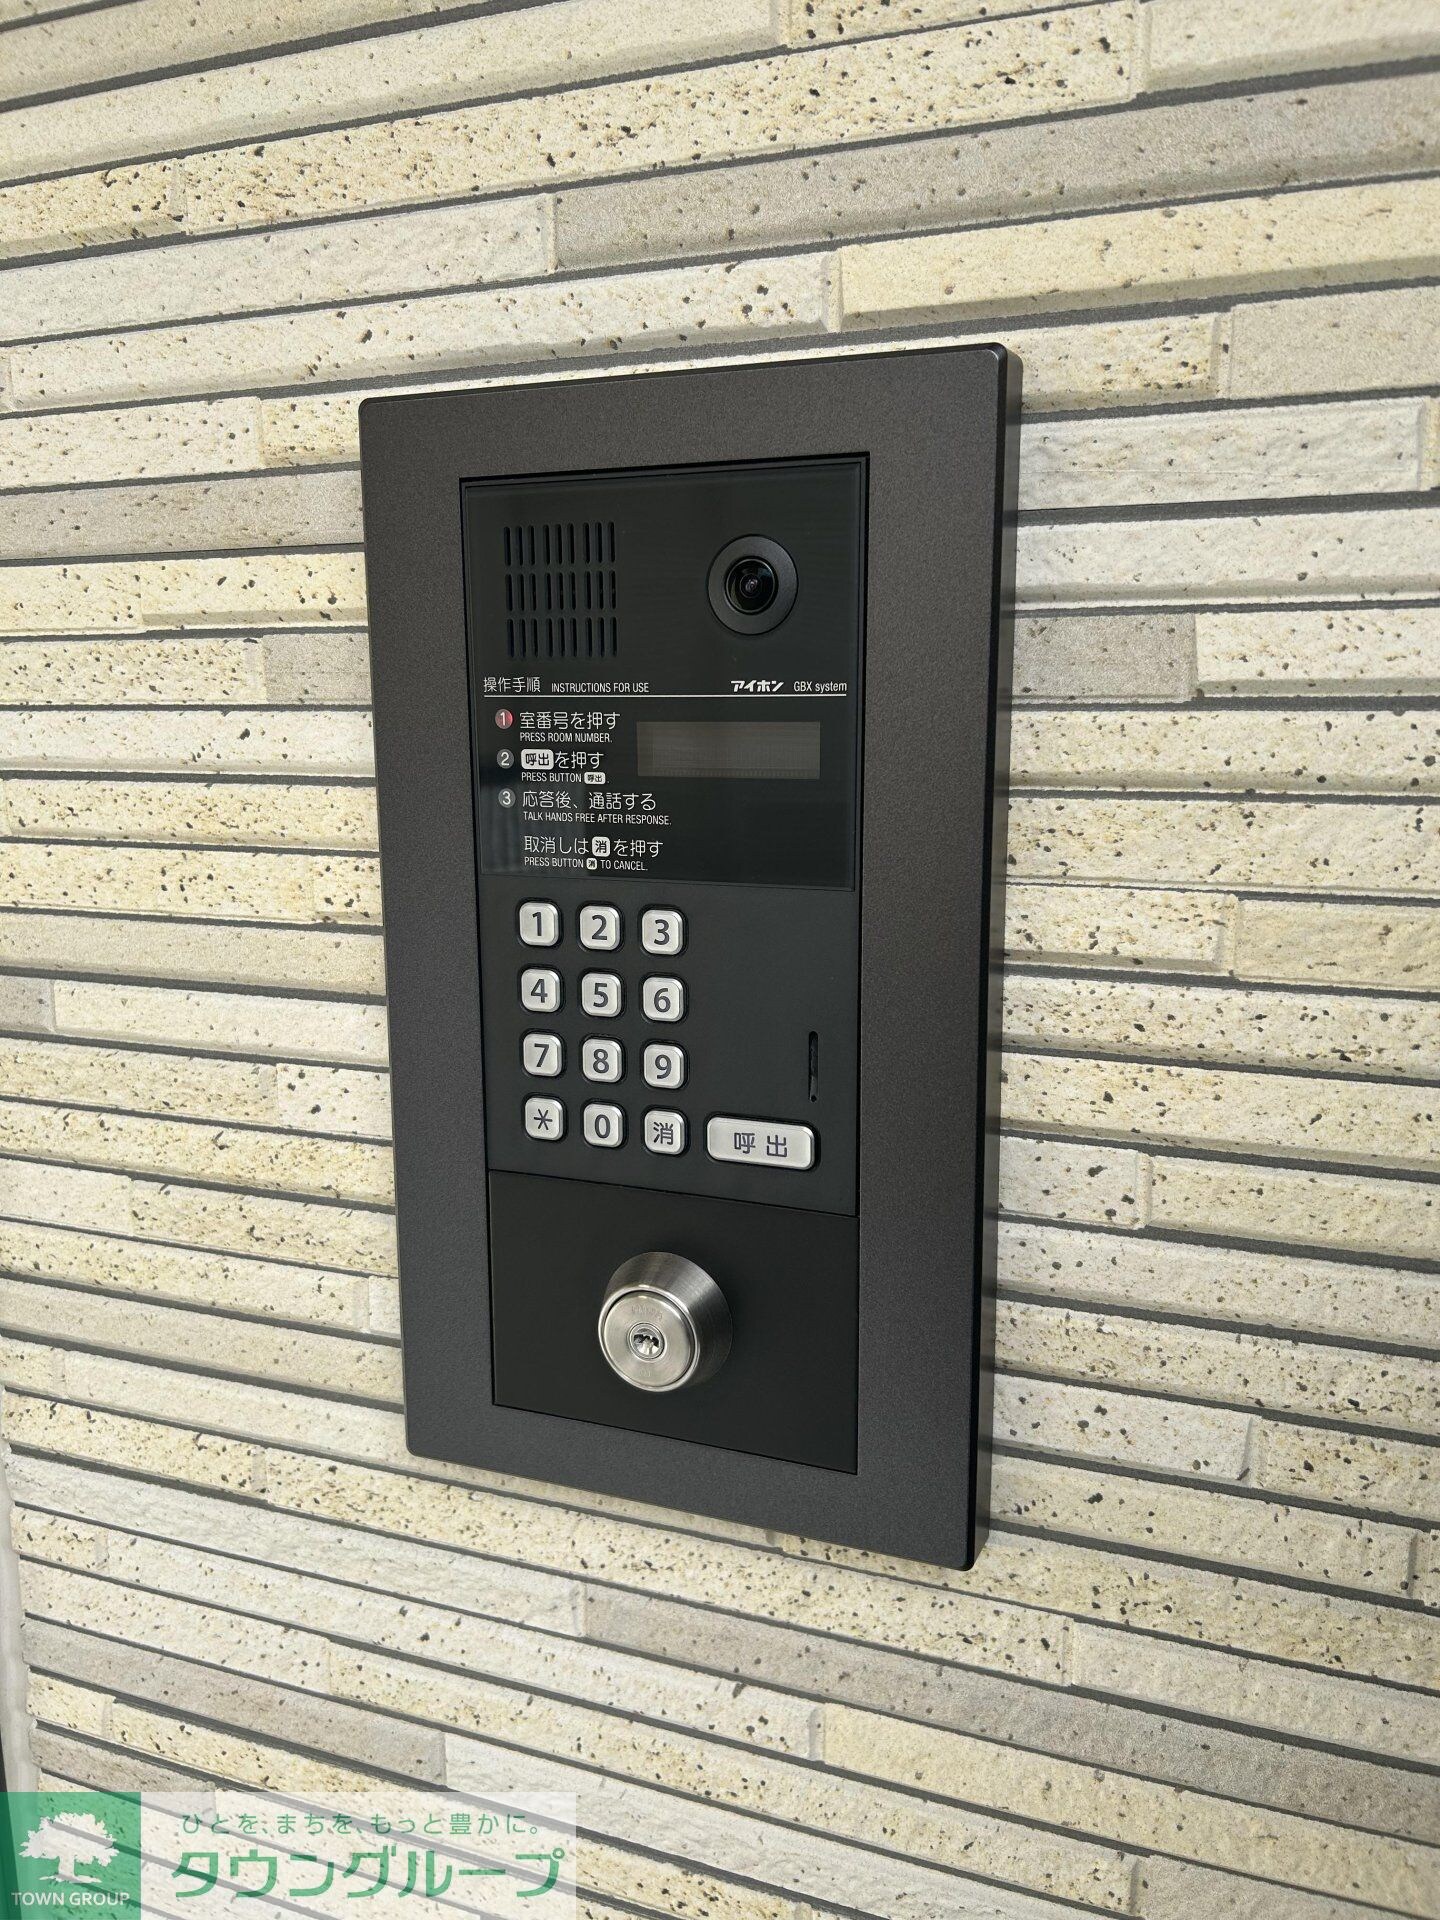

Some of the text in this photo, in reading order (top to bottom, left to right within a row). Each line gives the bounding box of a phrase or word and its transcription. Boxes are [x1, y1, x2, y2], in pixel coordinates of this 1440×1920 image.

[483, 676, 541, 693] 操作手順
[551, 682, 649, 693] INSTRUCTIONS FOR USE
[731, 680, 784, 693] アイホン
[793, 680, 847, 694] GBX system
[519, 711, 621, 730] 室番号を押す
[519, 732, 613, 743] PRESS ROOM NUMBER.
[521, 772, 547, 782] PRESS
[549, 772, 582, 783] BUTTON
[523, 812, 671, 826] TALK HANDS FREE AFTER RESPONSE.
[524, 857, 550, 867] PRESS
[552, 857, 584, 868] BUTTON
[601, 859, 611, 869] TO
[613, 860, 648, 871] CANCEL.
[531, 911, 543, 937] 1
[591, 914, 608, 941] 2
[653, 919, 670, 946] 3
[530, 978, 548, 1003] 4
[593, 982, 609, 1008] 5
[653, 987, 671, 1013] 6
[534, 1043, 550, 1068] 7
[592, 1048, 610, 1074] 8
[654, 1054, 672, 1080] 9
[594, 1114, 610, 1139] 0
[653, 1121, 674, 1146] 消
[733, 1132, 788, 1158] 呼出
